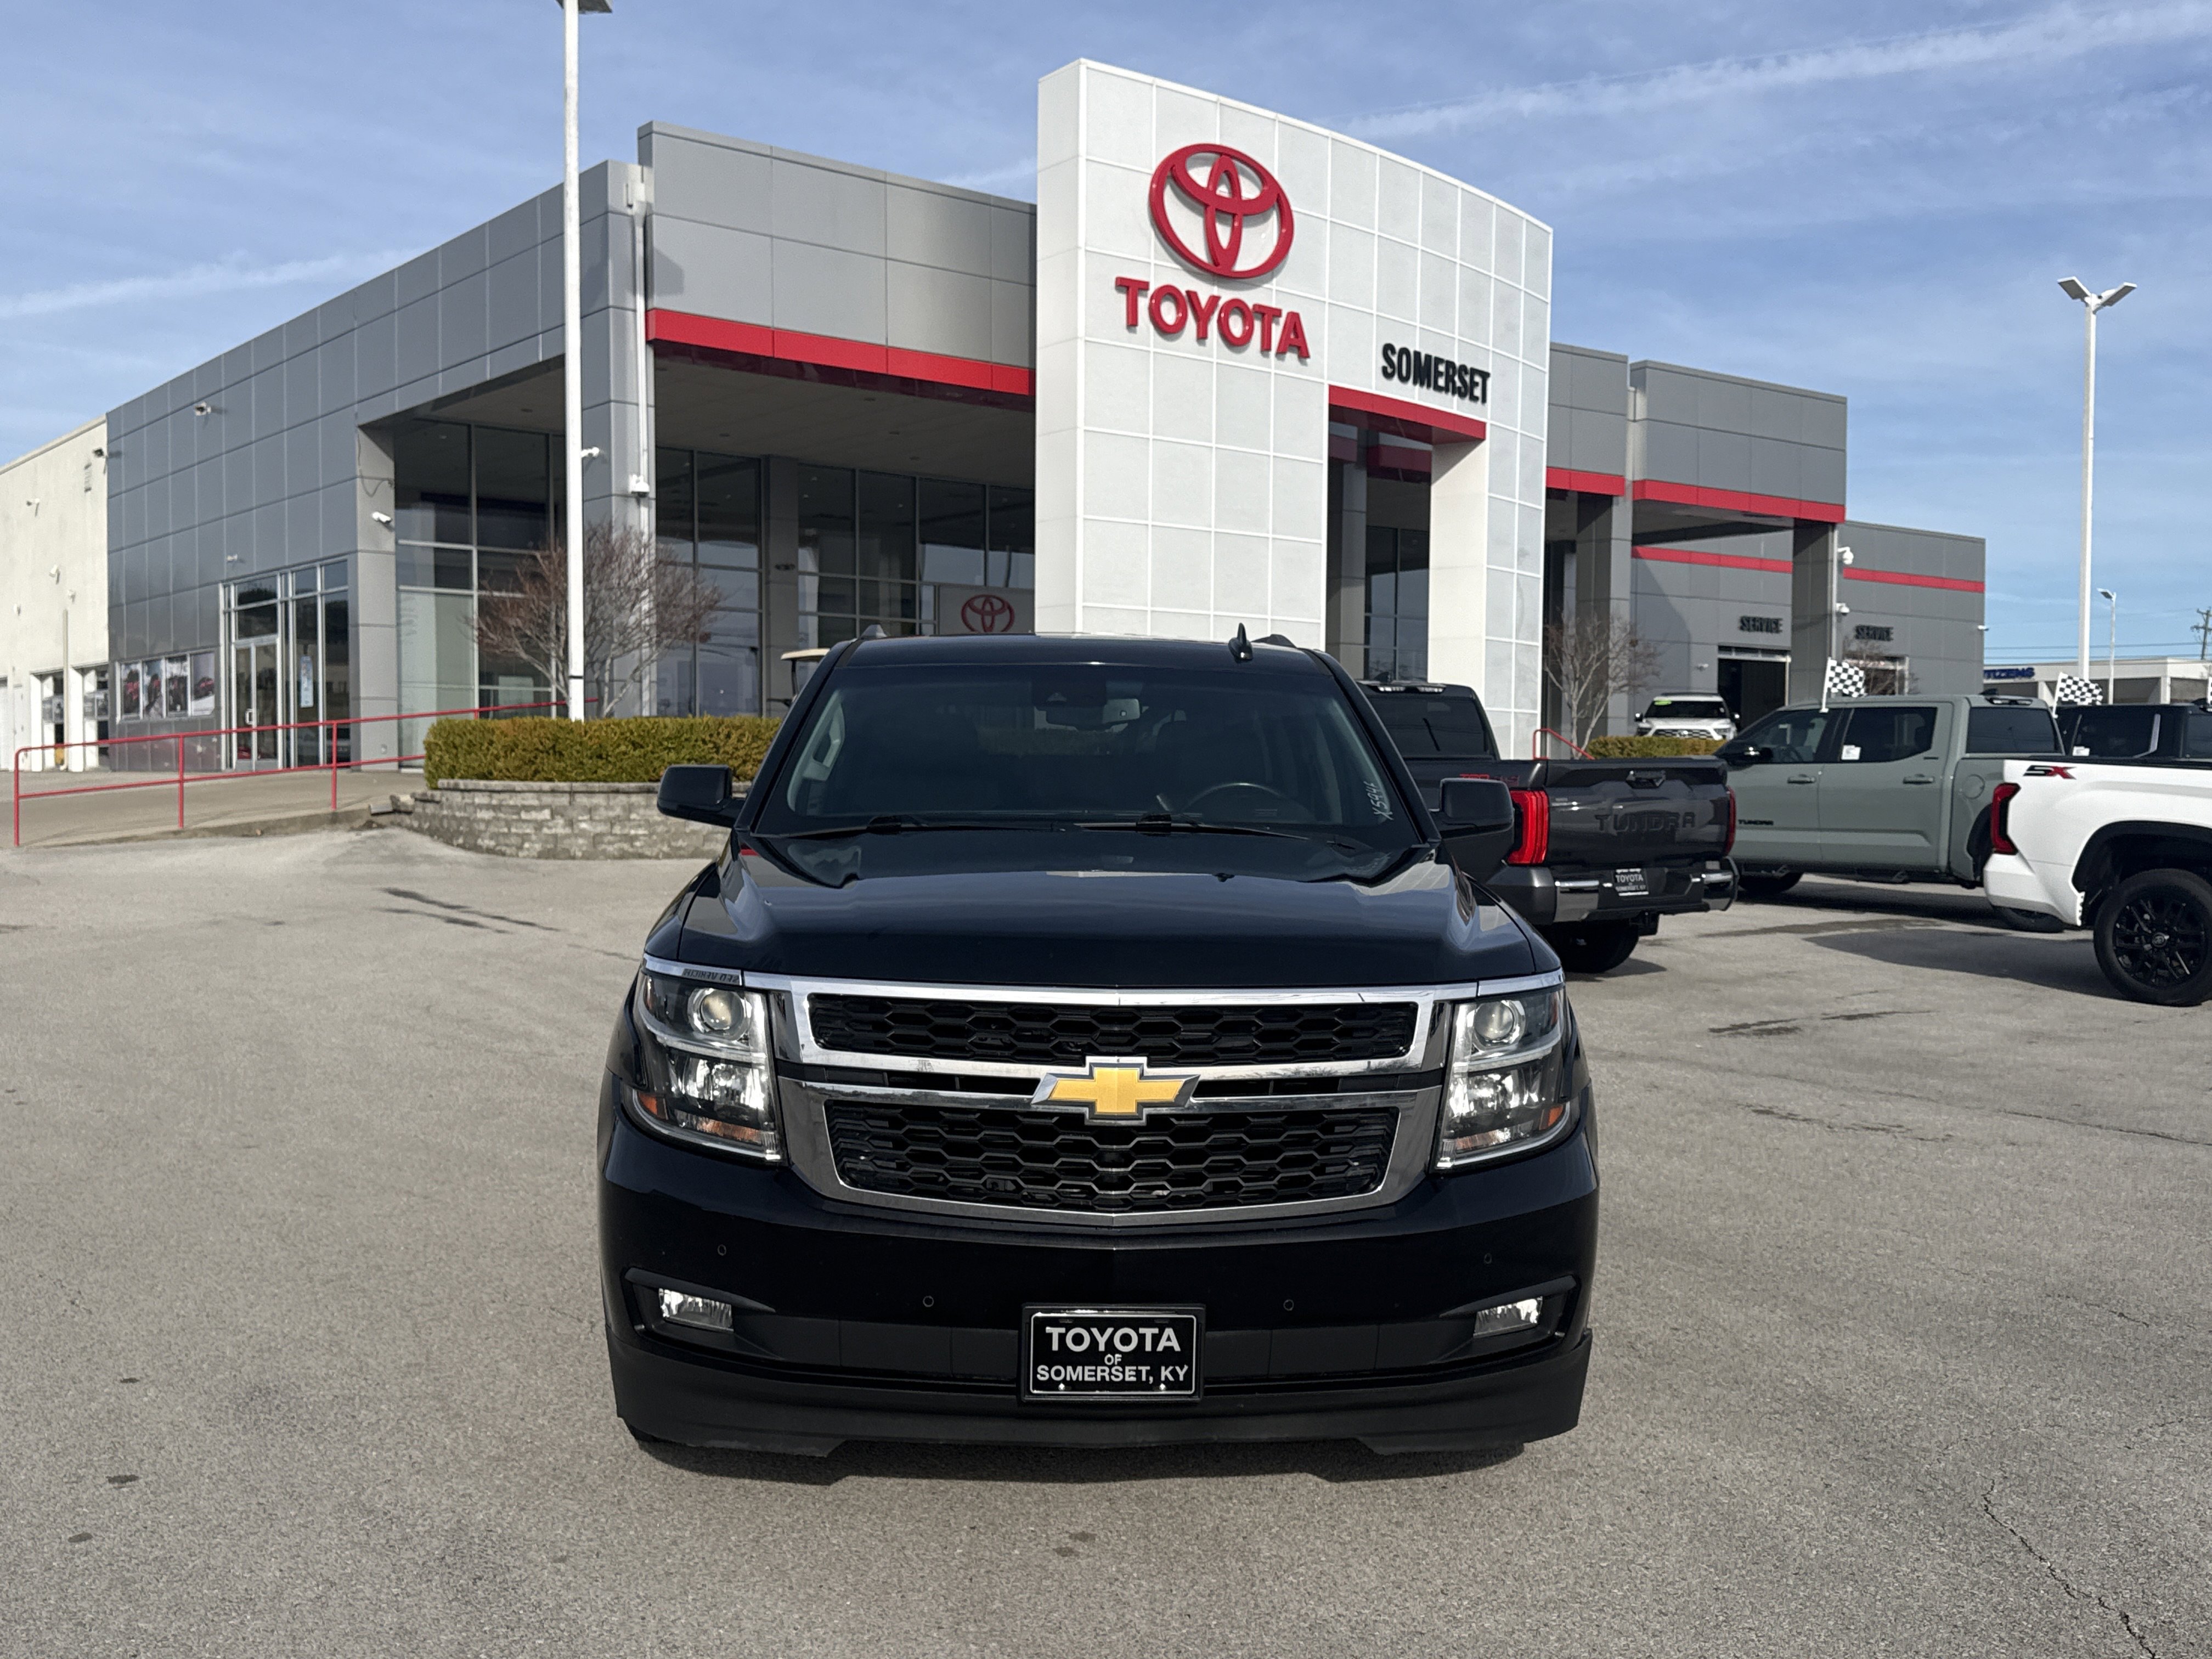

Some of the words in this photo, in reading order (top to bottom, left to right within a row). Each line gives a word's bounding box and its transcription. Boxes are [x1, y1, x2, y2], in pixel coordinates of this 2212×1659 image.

[1115, 276, 1311, 359] TOYOTA
[1382, 343, 1491, 404] SOMERSET
[1594, 810, 1696, 832] TUNDRA
[1615, 874, 1644, 883] TOYOTA
[1046, 1327, 1181, 1352] TOYOTA
[1104, 1353, 1122, 1365] OF
[1036, 1365, 1153, 1384] SOMERSET,
[1161, 1364, 1188, 1381] KY
